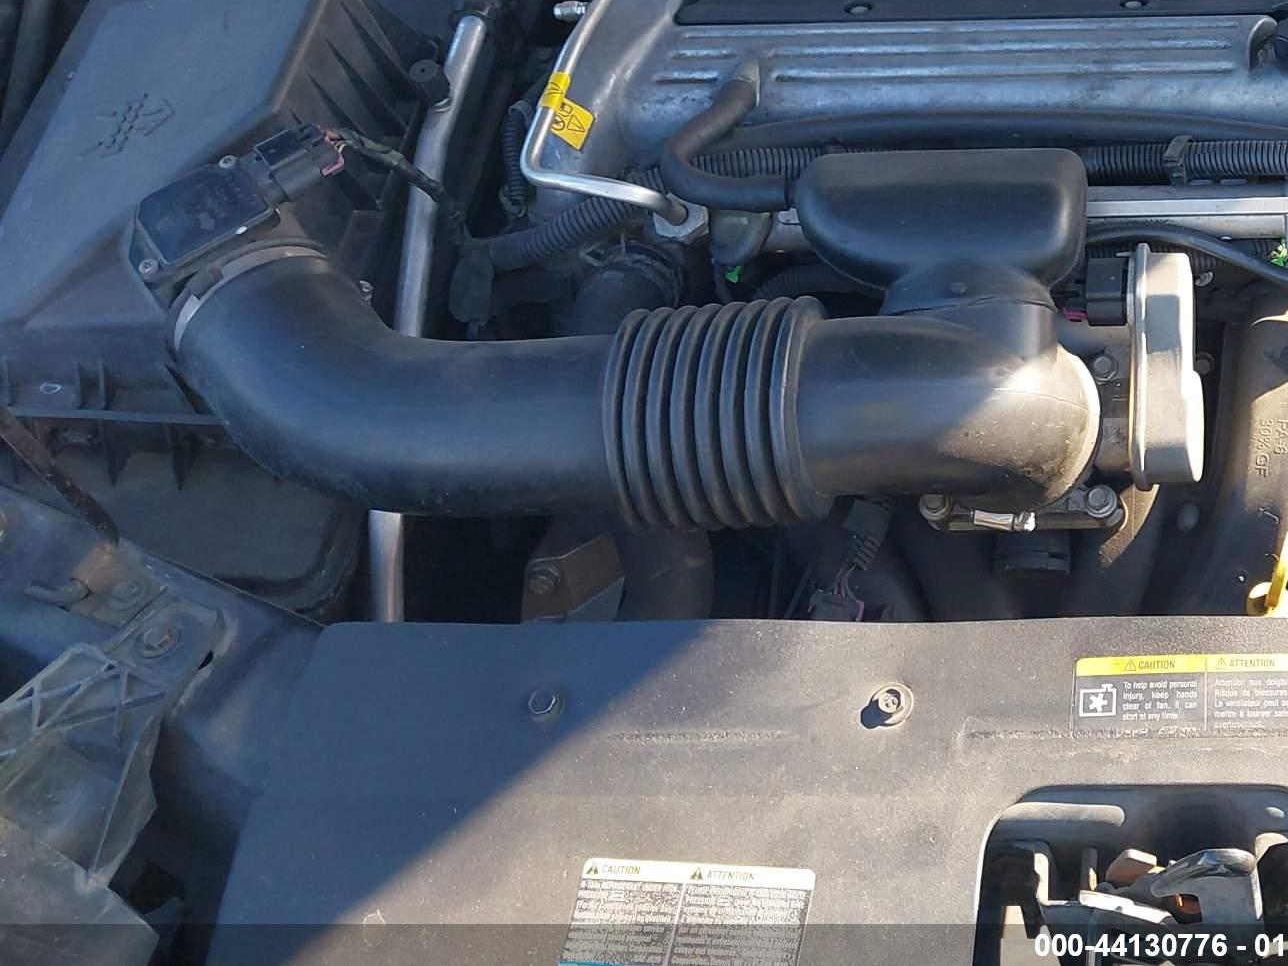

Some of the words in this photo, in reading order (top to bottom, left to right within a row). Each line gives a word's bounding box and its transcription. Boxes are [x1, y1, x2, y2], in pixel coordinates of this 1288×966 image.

[1254, 452, 1271, 478] GF
[1138, 660, 1175, 670] CAUTION
[1230, 659, 1275, 667] ATTENTION
[1123, 681, 1132, 689] To
[1133, 681, 1148, 690] help
[1149, 680, 1168, 689] avoid
[1169, 679, 1198, 689] personal
[1151, 691, 1169, 699] keep
[1176, 690, 1198, 699] hands
[1122, 702, 1140, 710] clear
[1144, 701, 1152, 709] of
[1184, 701, 1198, 709] can
[1214, 700, 1224, 708] Le
[1147, 714, 1161, 722] any
[601, 864, 641, 874] CAUTION
[706, 870, 756, 881] ATTENTION
